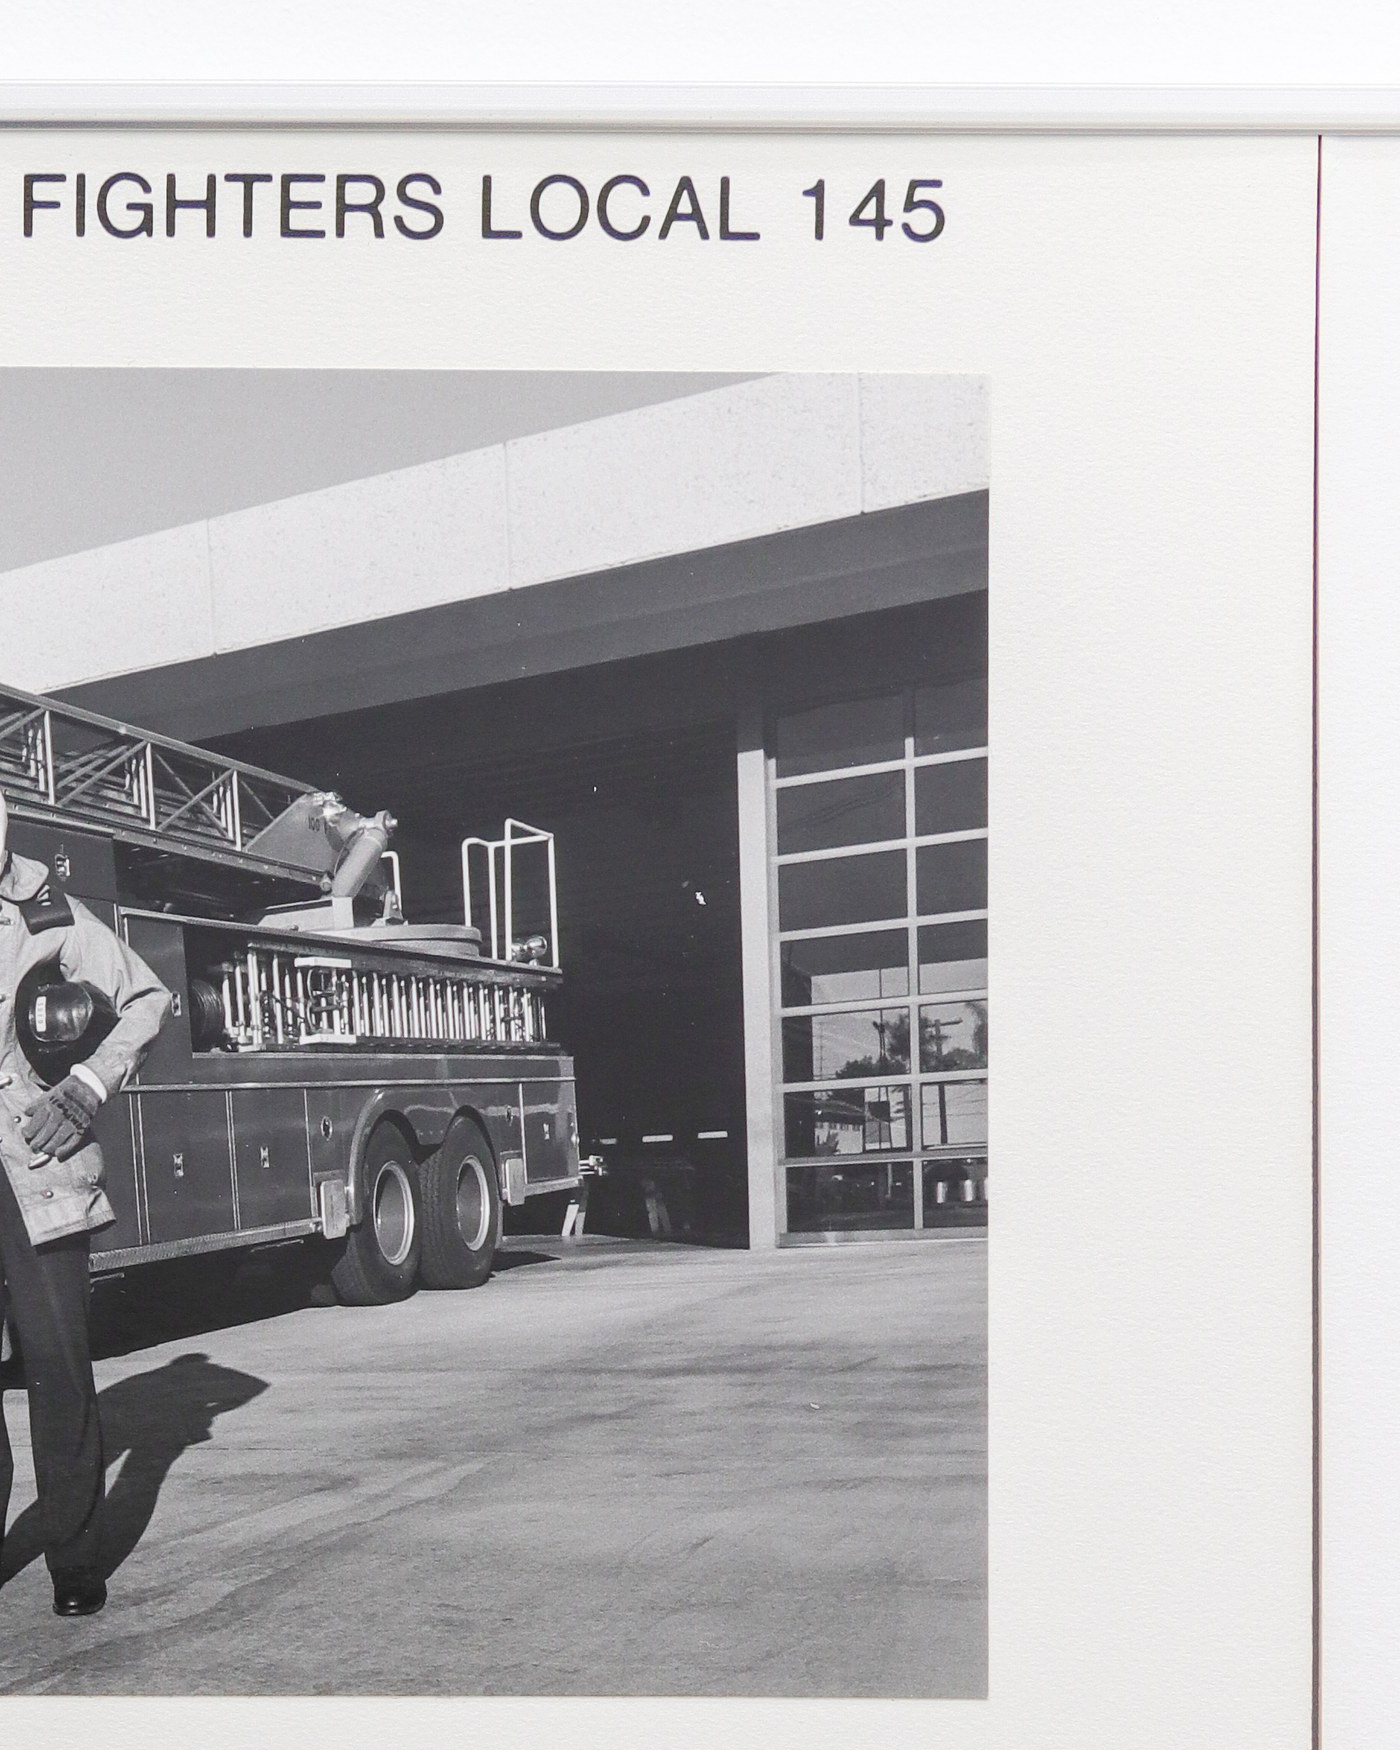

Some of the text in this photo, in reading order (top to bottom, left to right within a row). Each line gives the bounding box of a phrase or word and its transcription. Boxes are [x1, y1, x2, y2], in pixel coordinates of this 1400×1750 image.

[24, 172, 443, 239] FIGHTERS
[482, 175, 760, 241] LOCAL
[803, 179, 944, 242] 145
